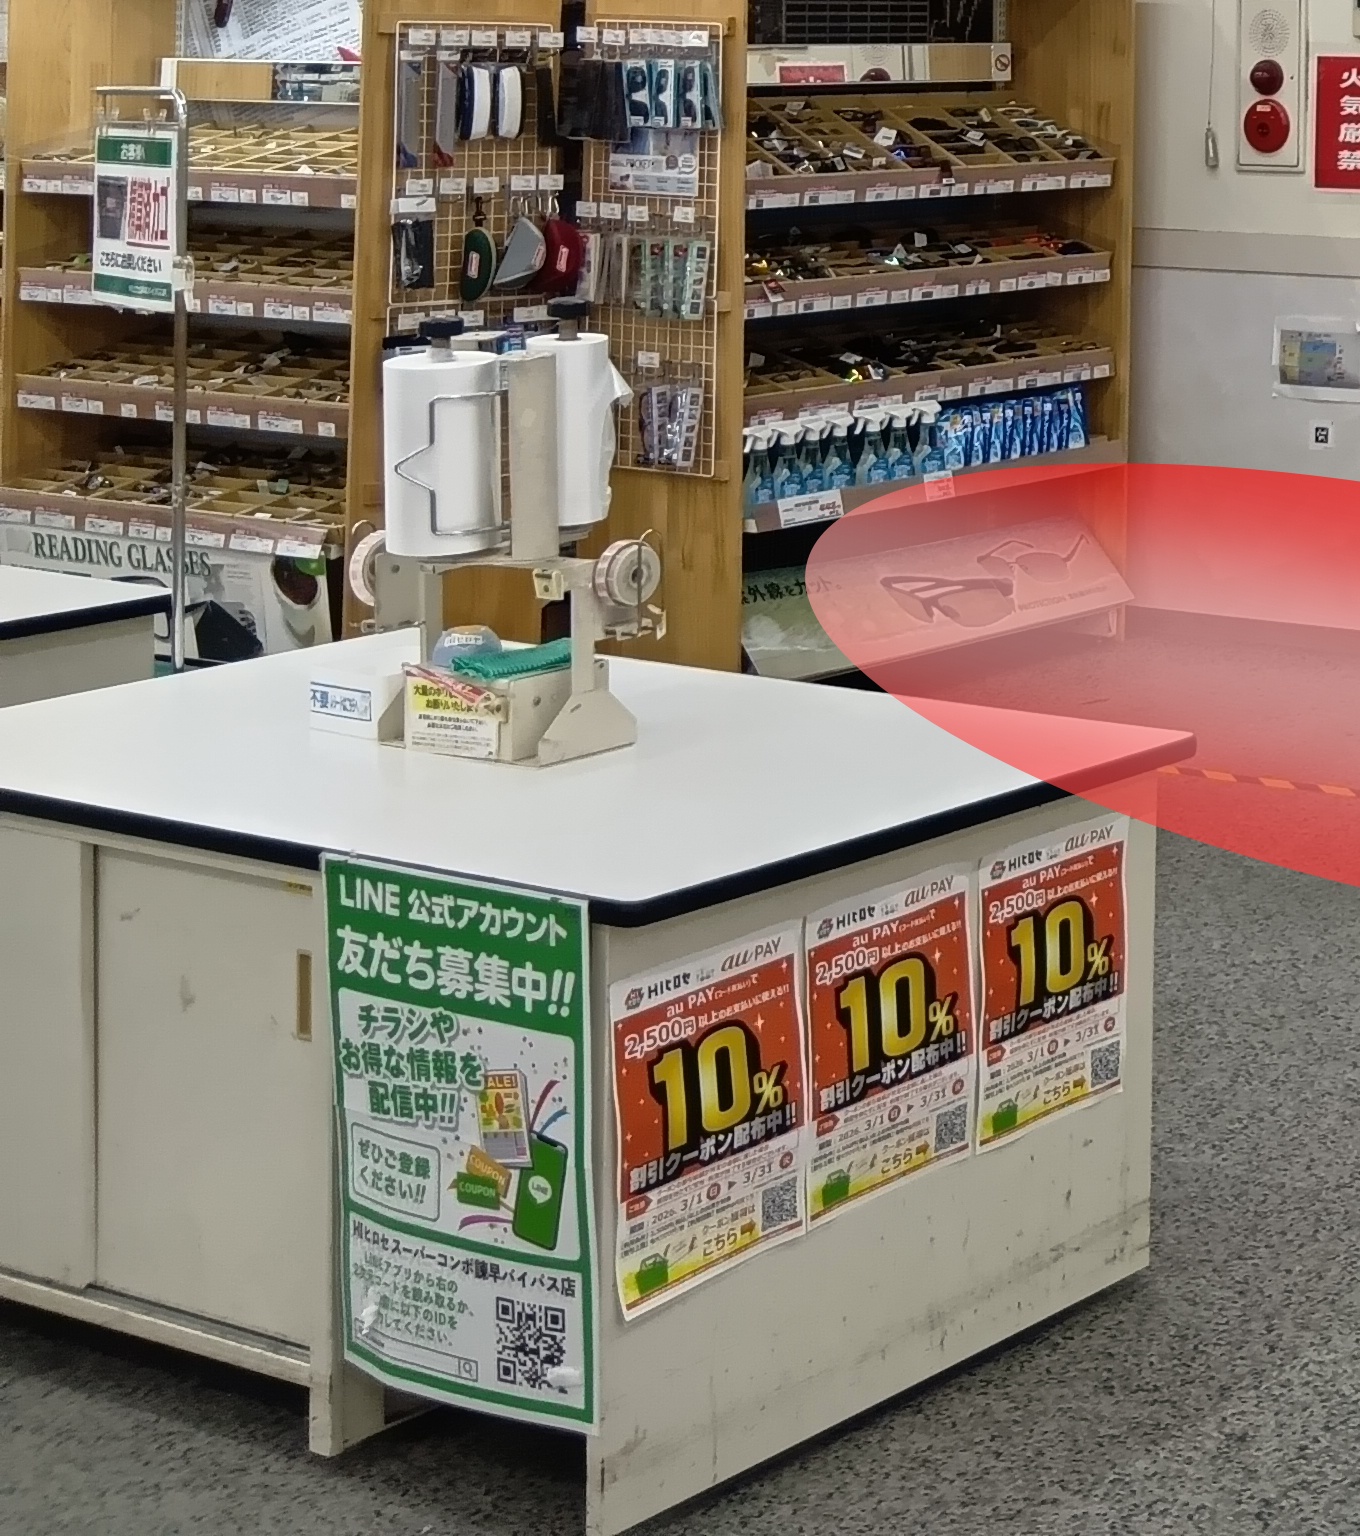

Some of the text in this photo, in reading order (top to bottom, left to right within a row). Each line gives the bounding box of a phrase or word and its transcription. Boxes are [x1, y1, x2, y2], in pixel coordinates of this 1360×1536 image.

[32, 531, 123, 568] READING
[1090, 825, 1114, 843] PAY
[930, 875, 954, 897] PAY
[1022, 876, 1036, 889] au
[339, 873, 568, 947] LINE 公式アカウント
[720, 951, 753, 973] au
[754, 936, 782, 961] PAY
[852, 933, 868, 948] au
[1011, 900, 1109, 1007] 10%
[336, 924, 576, 1018] 友だち募集中!!
[816, 946, 880, 986] 2,500円
[357, 1004, 457, 1044] チラシや
[666, 1004, 684, 1018] au
[839, 957, 954, 1073] 10%
[624, 1015, 696, 1060] 2,500円
[340, 1037, 485, 1089] お得な情報を
[484, 1072, 518, 1089] ALE!
[653, 1025, 784, 1151] 10%
[357, 1137, 431, 1180] ぜひご登録
[458, 1179, 496, 1198] COUPON
[702, 1227, 738, 1258] こちら
